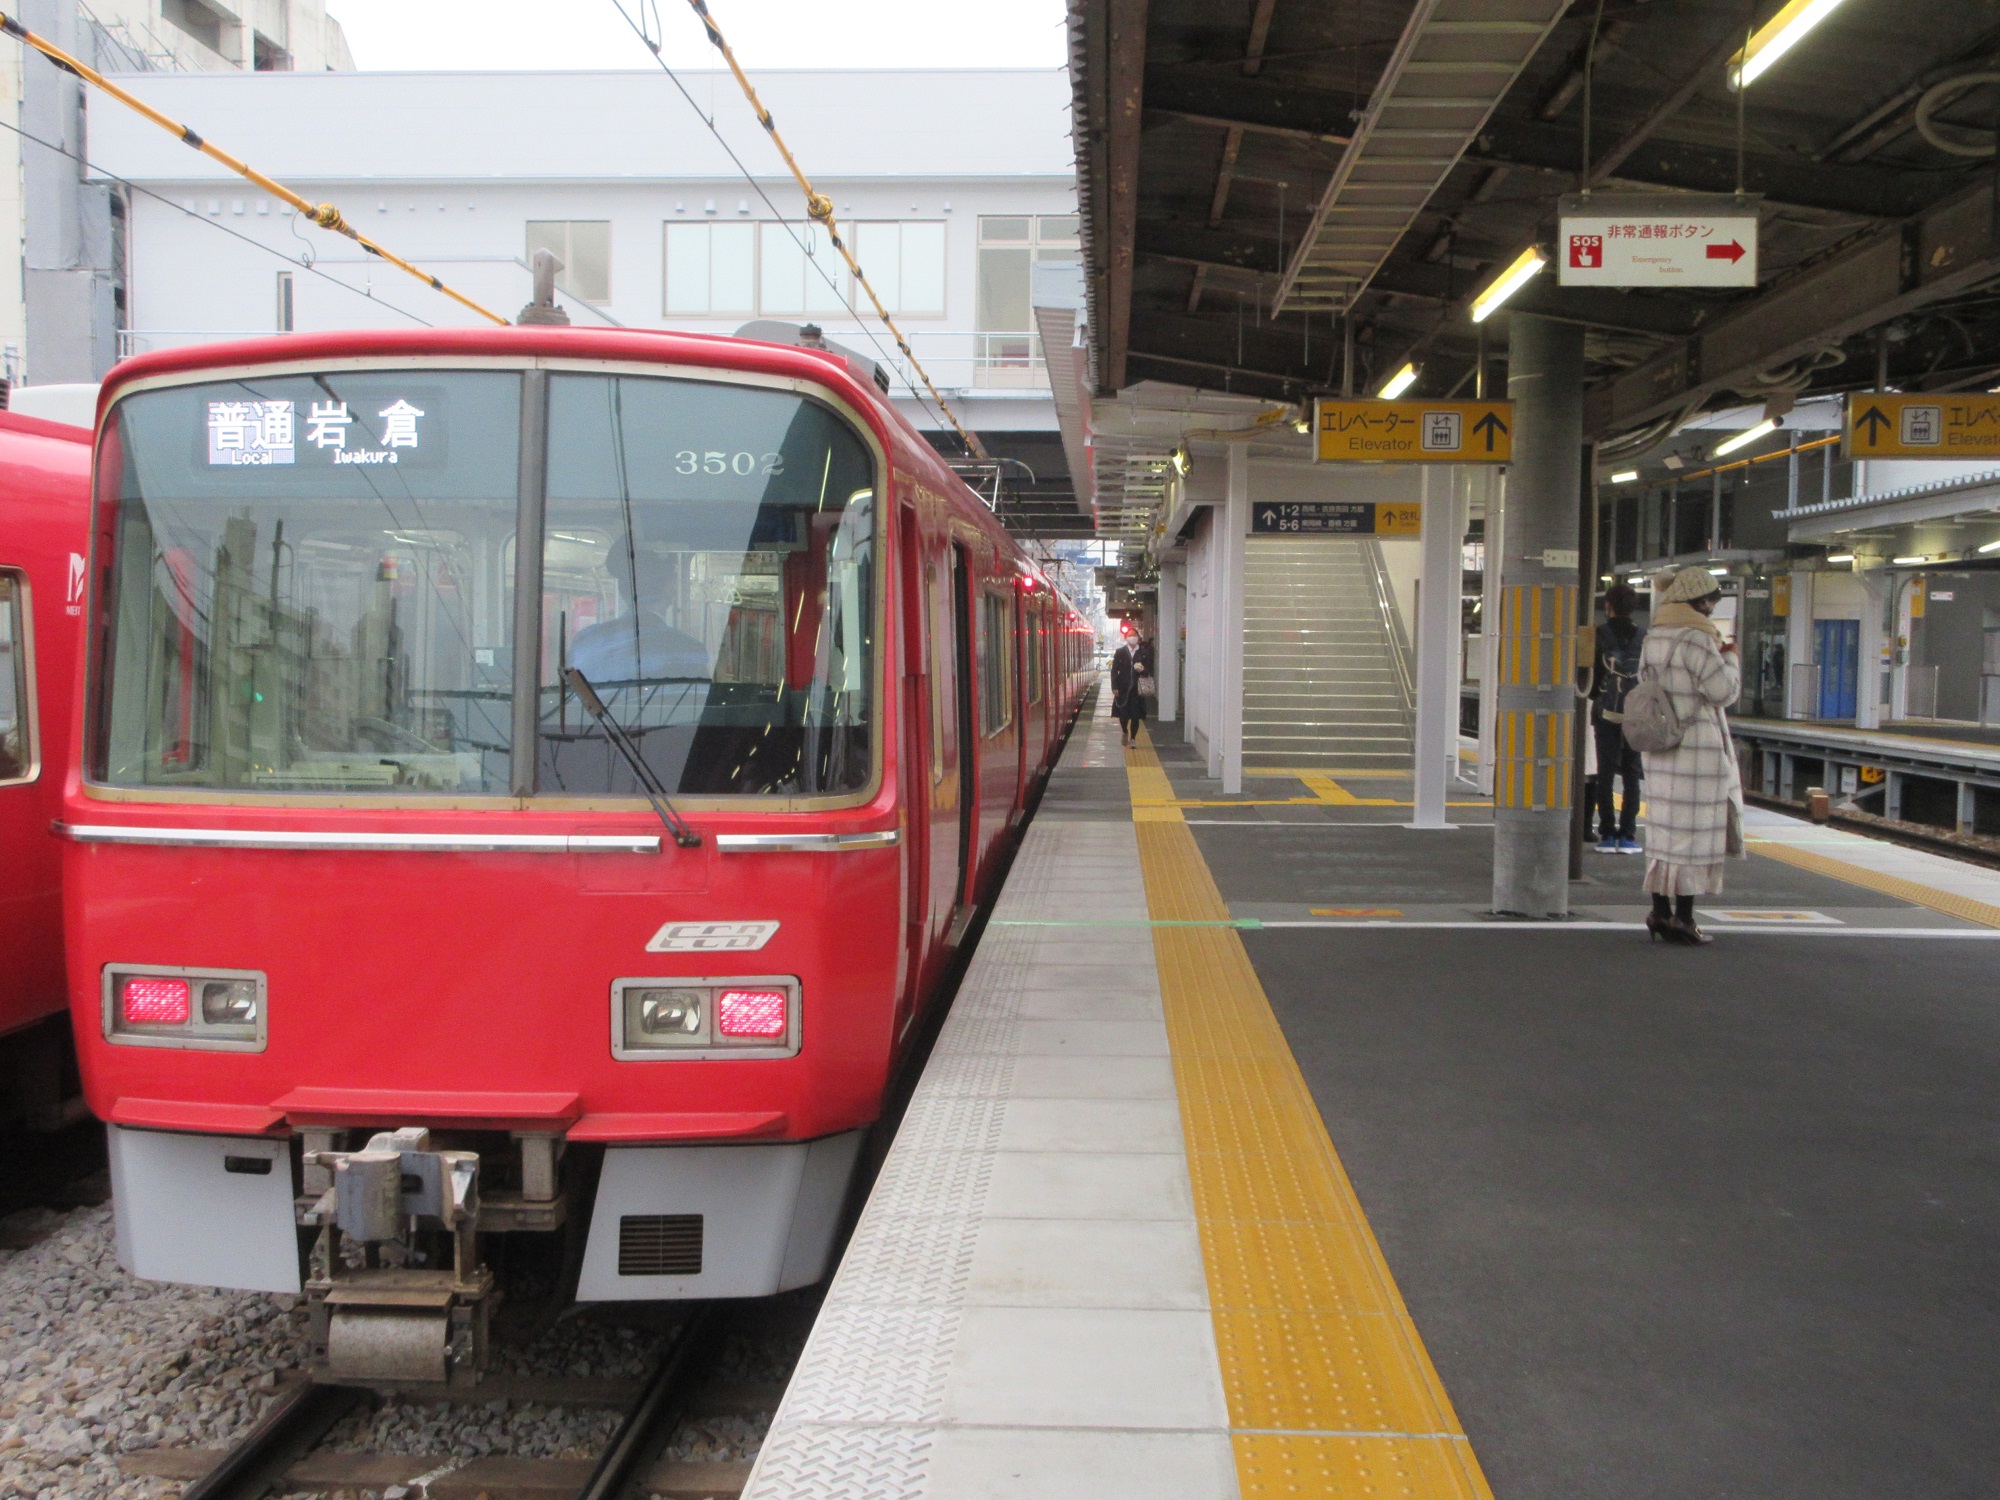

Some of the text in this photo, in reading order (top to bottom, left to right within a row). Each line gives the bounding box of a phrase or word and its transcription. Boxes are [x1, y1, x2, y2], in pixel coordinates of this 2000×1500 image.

[1607, 224, 1715, 239] 非常通報ボタン
[1572, 236, 1600, 247] SOS
[1631, 255, 1673, 264] Emergency
[1322, 411, 1416, 433] エレベーター
[1948, 405, 2000, 427] エレベ
[208, 399, 425, 450] 普通 岩倉
[1349, 437, 1414, 451] Elevator
[231, 449, 398, 465] Local Iwakura
[675, 450, 785, 476] 3502
